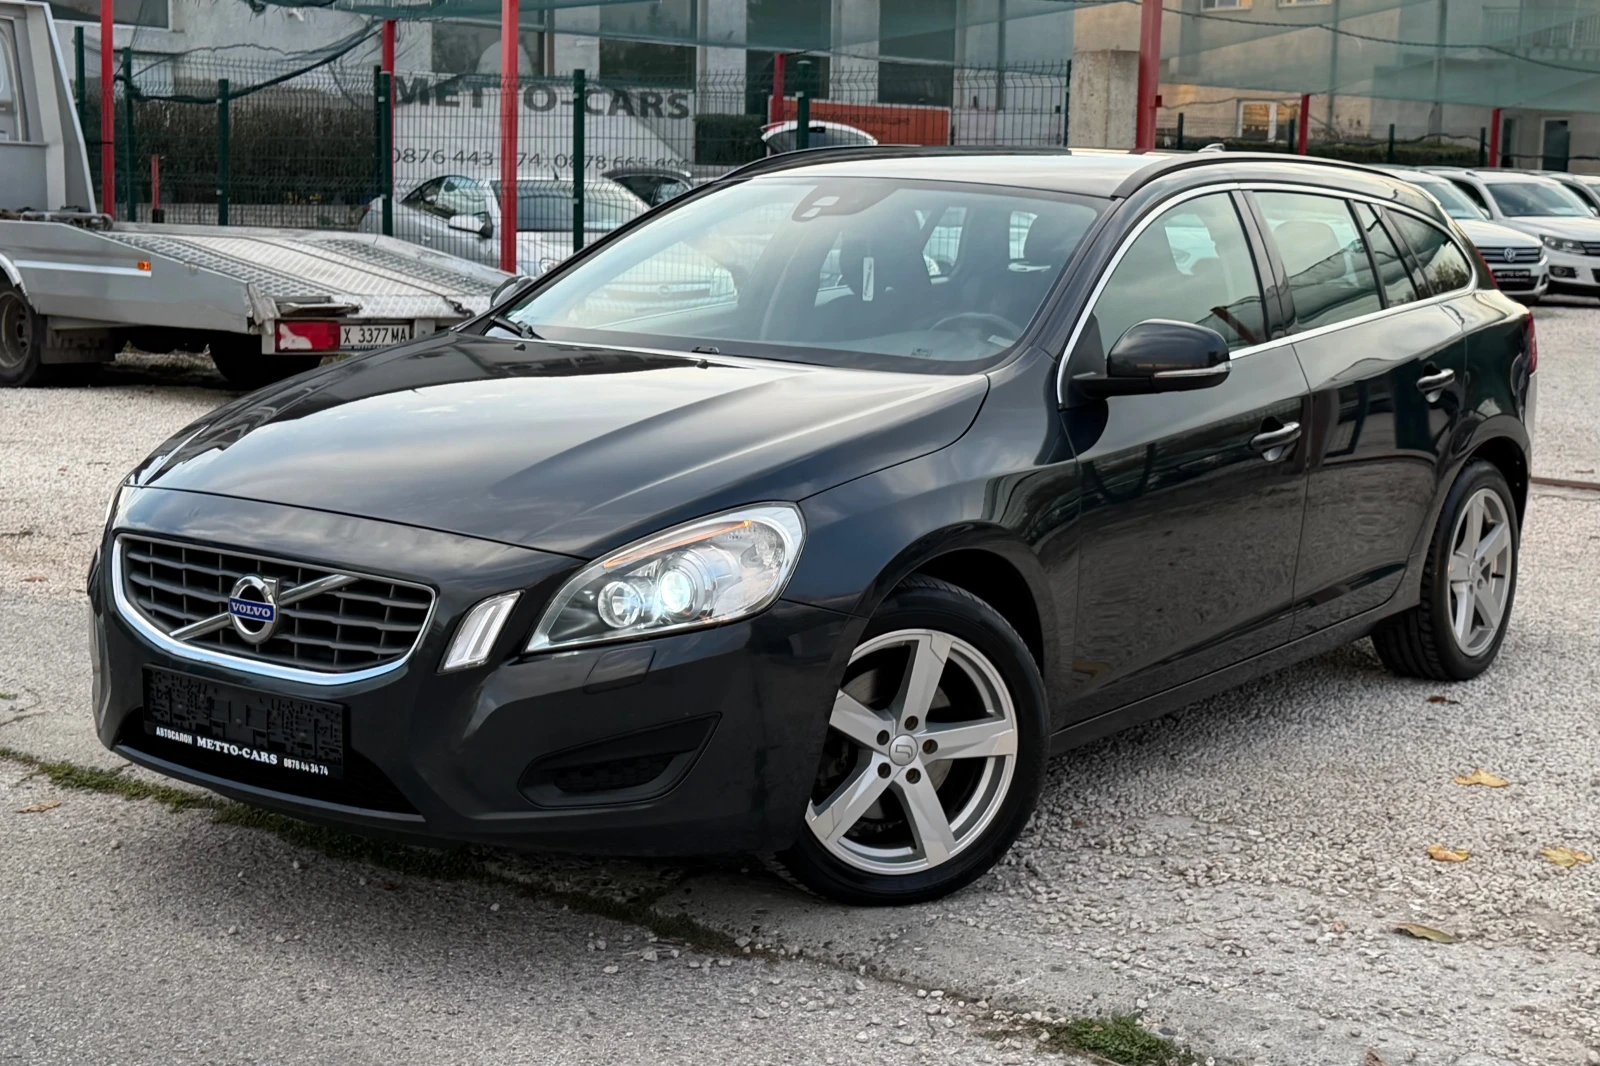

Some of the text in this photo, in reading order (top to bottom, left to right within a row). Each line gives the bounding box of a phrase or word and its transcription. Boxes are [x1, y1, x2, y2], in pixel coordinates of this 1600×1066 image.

[394, 75, 689, 120] METO-CARS
[343, 327, 407, 344] X 3377 MA
[231, 601, 271, 618] VOLVO
[196, 735, 278, 765] METTO-CARS
